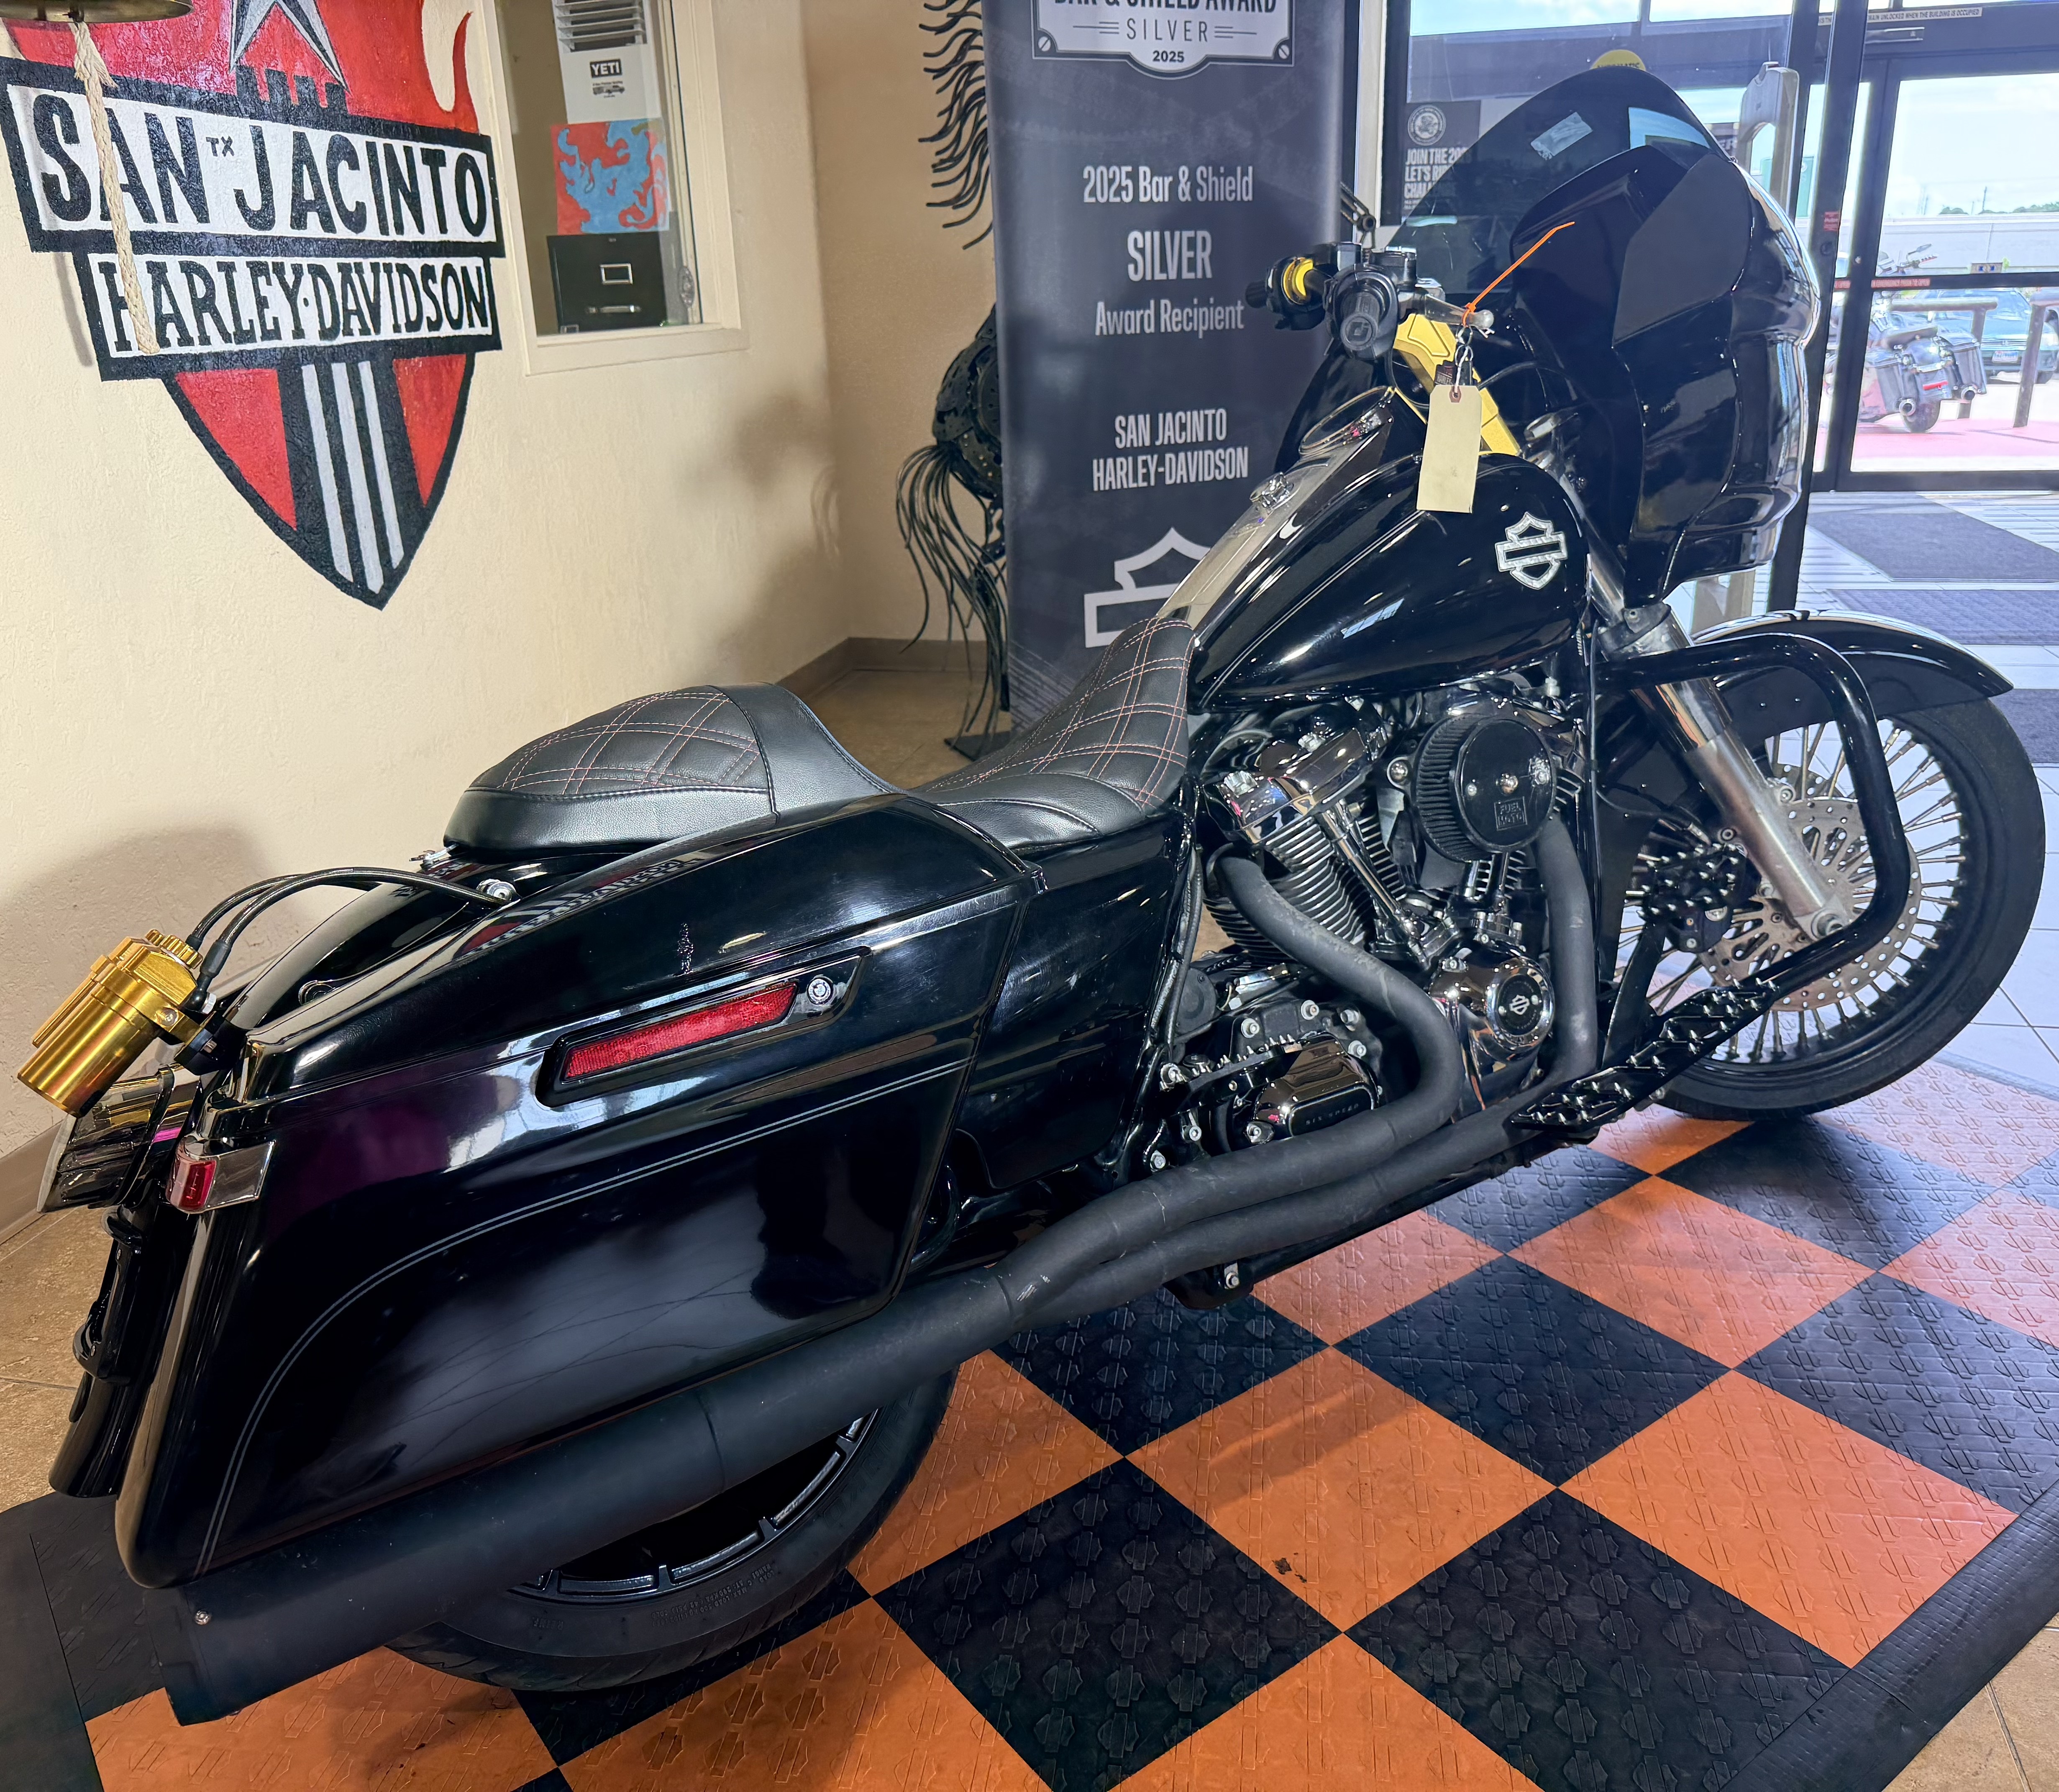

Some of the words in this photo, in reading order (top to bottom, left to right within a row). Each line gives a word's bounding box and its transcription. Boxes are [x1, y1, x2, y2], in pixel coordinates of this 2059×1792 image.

[1127, 18, 1208, 42] SILVER
[1152, 50, 1185, 62] 2025
[591, 61, 620, 76] YETI
[205, 135, 234, 157] TX
[1406, 148, 1429, 165] JOIN
[1429, 148, 1448, 164] THE
[33, 94, 210, 223] SAN
[233, 125, 488, 238] JACINTO
[1083, 166, 1134, 203] 2025
[1138, 167, 1173, 202] Bar
[1178, 166, 1192, 202] &
[1196, 166, 1254, 202] Shield
[1127, 230, 1212, 281] SILVER
[1095, 300, 1155, 336] Award
[1160, 298, 1245, 338] Recipient
[1115, 414, 1151, 449] SAN
[1155, 408, 1227, 446] JACINTO
[1092, 446, 1249, 492] HARLEY-DAVIDSON
[719, 1586, 731, 1597] 290
[700, 1603, 712, 1613] 500
